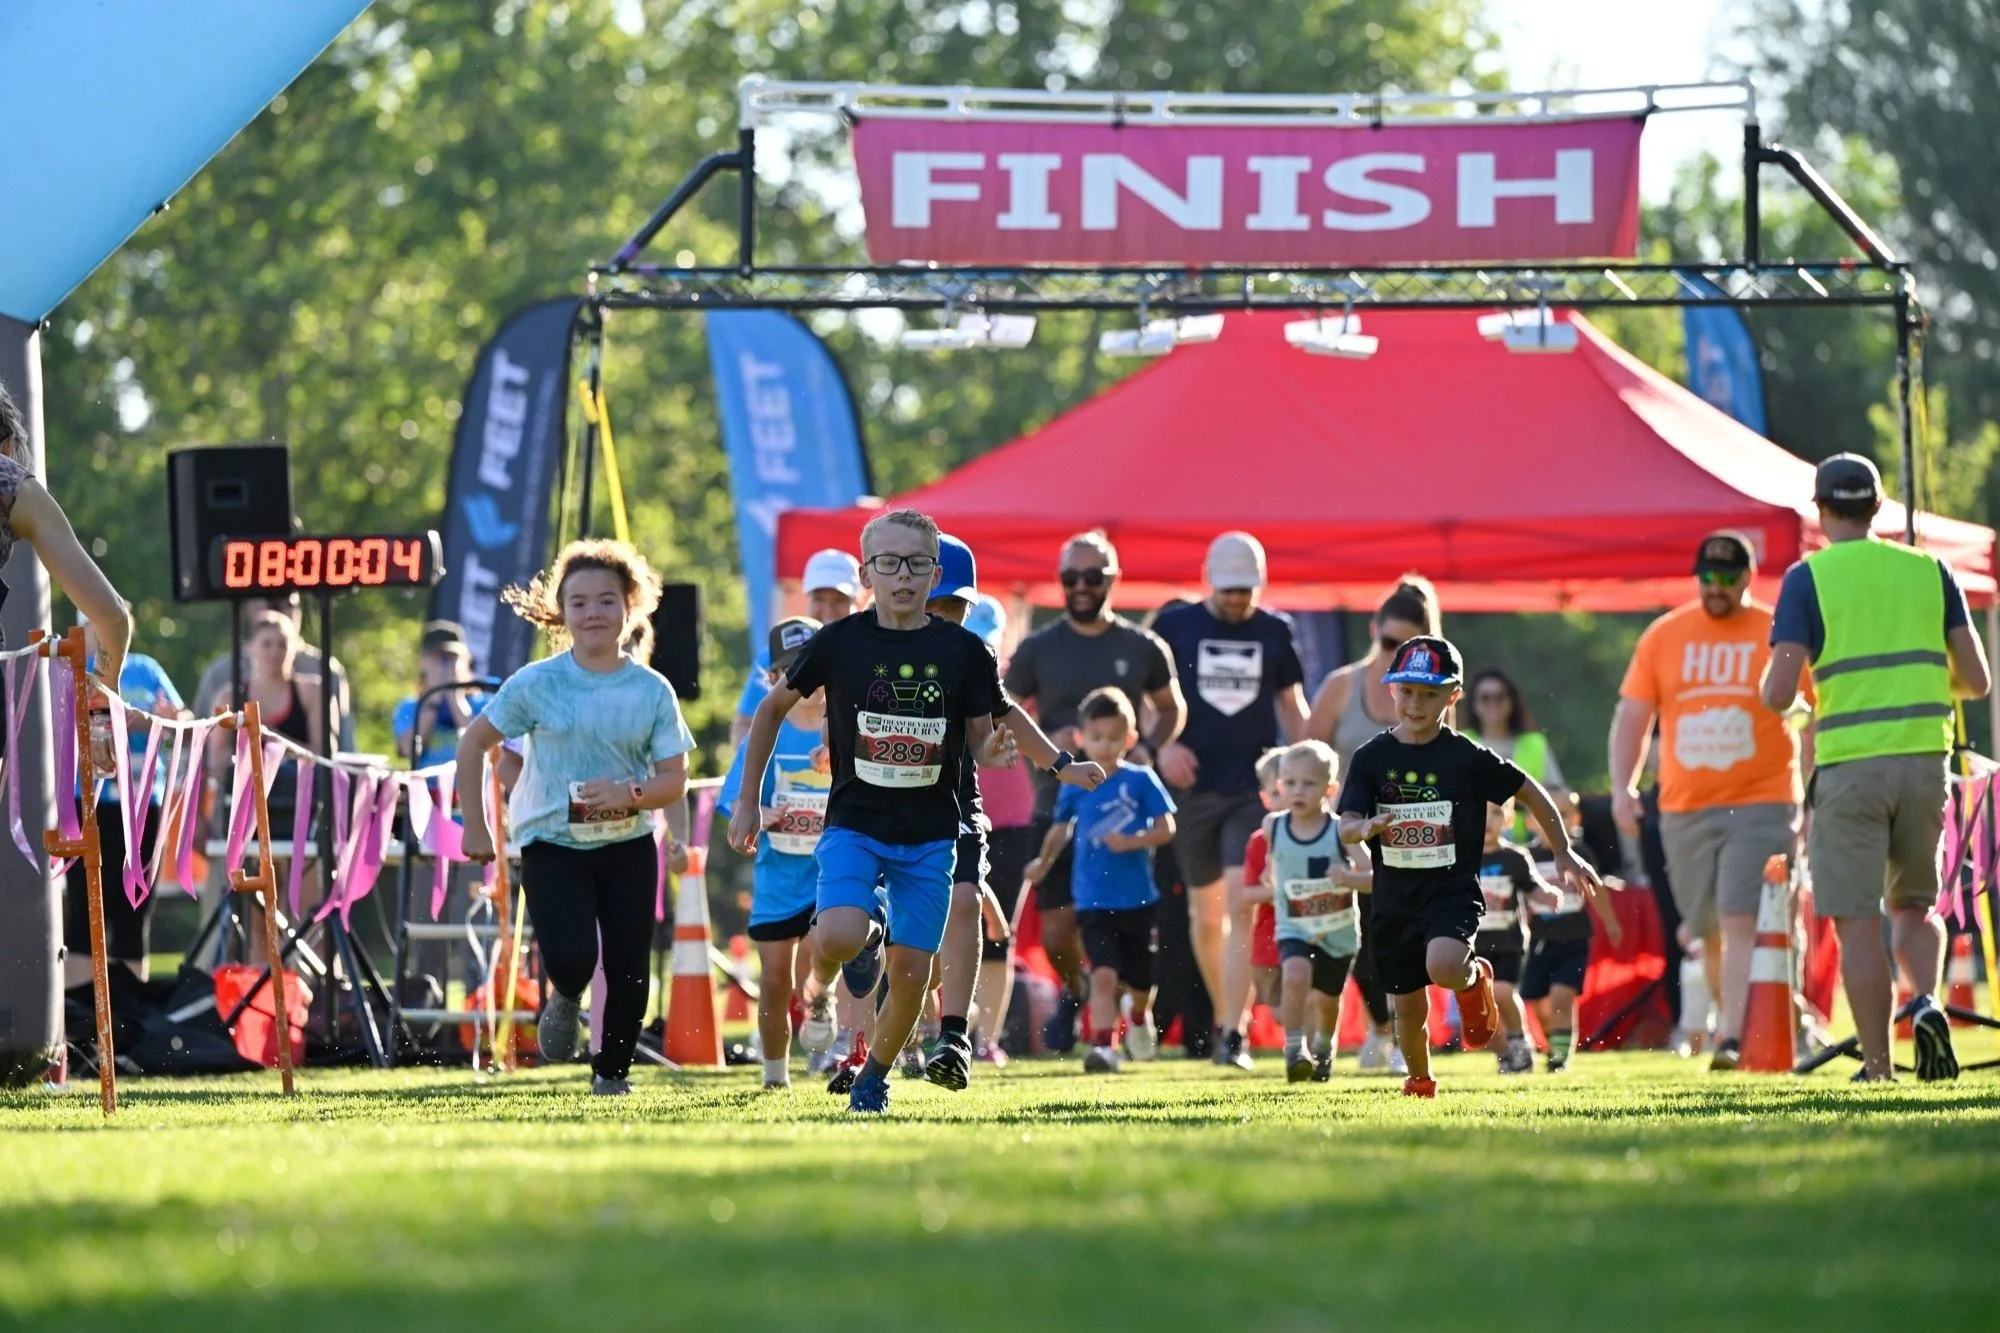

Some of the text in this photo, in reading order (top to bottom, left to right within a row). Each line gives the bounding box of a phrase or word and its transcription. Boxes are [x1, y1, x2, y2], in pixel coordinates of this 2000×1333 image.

[892, 149, 1593, 231] FINISH
[477, 347, 530, 490] FEET
[739, 350, 801, 484] FEET
[226, 539, 421, 588] 08:00:04
[1682, 641, 1758, 685] HOT
[881, 724, 939, 736] RESCUE RUN
[883, 719, 917, 727] TREASURE
[873, 739, 926, 765] 289
[783, 815, 824, 833] 293
[1427, 810, 1445, 818] RUN
[1391, 825, 1437, 848] 288
